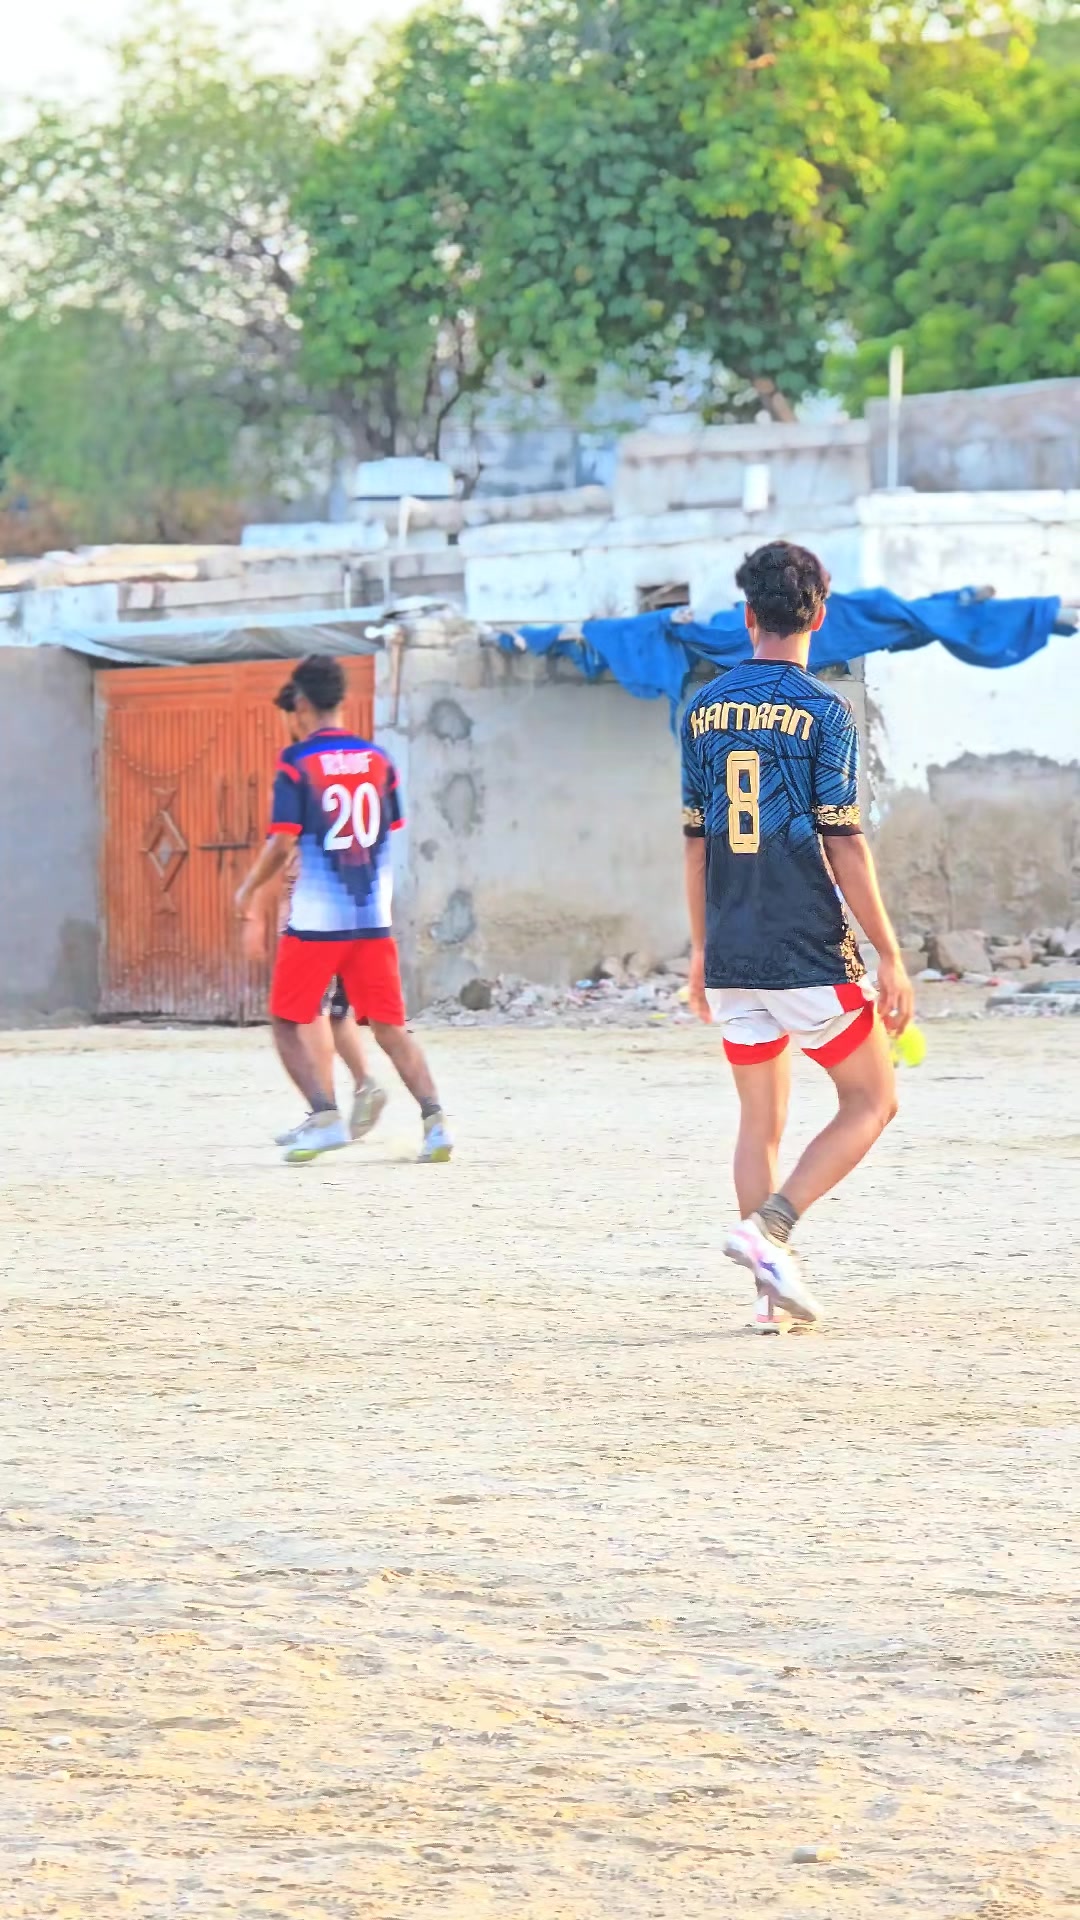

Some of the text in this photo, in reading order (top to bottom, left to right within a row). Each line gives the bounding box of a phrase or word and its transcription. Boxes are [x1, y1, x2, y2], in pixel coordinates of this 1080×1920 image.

[691, 702, 814, 741] KAMRAN
[322, 782, 381, 851] 20
[726, 750, 760, 854] 8
